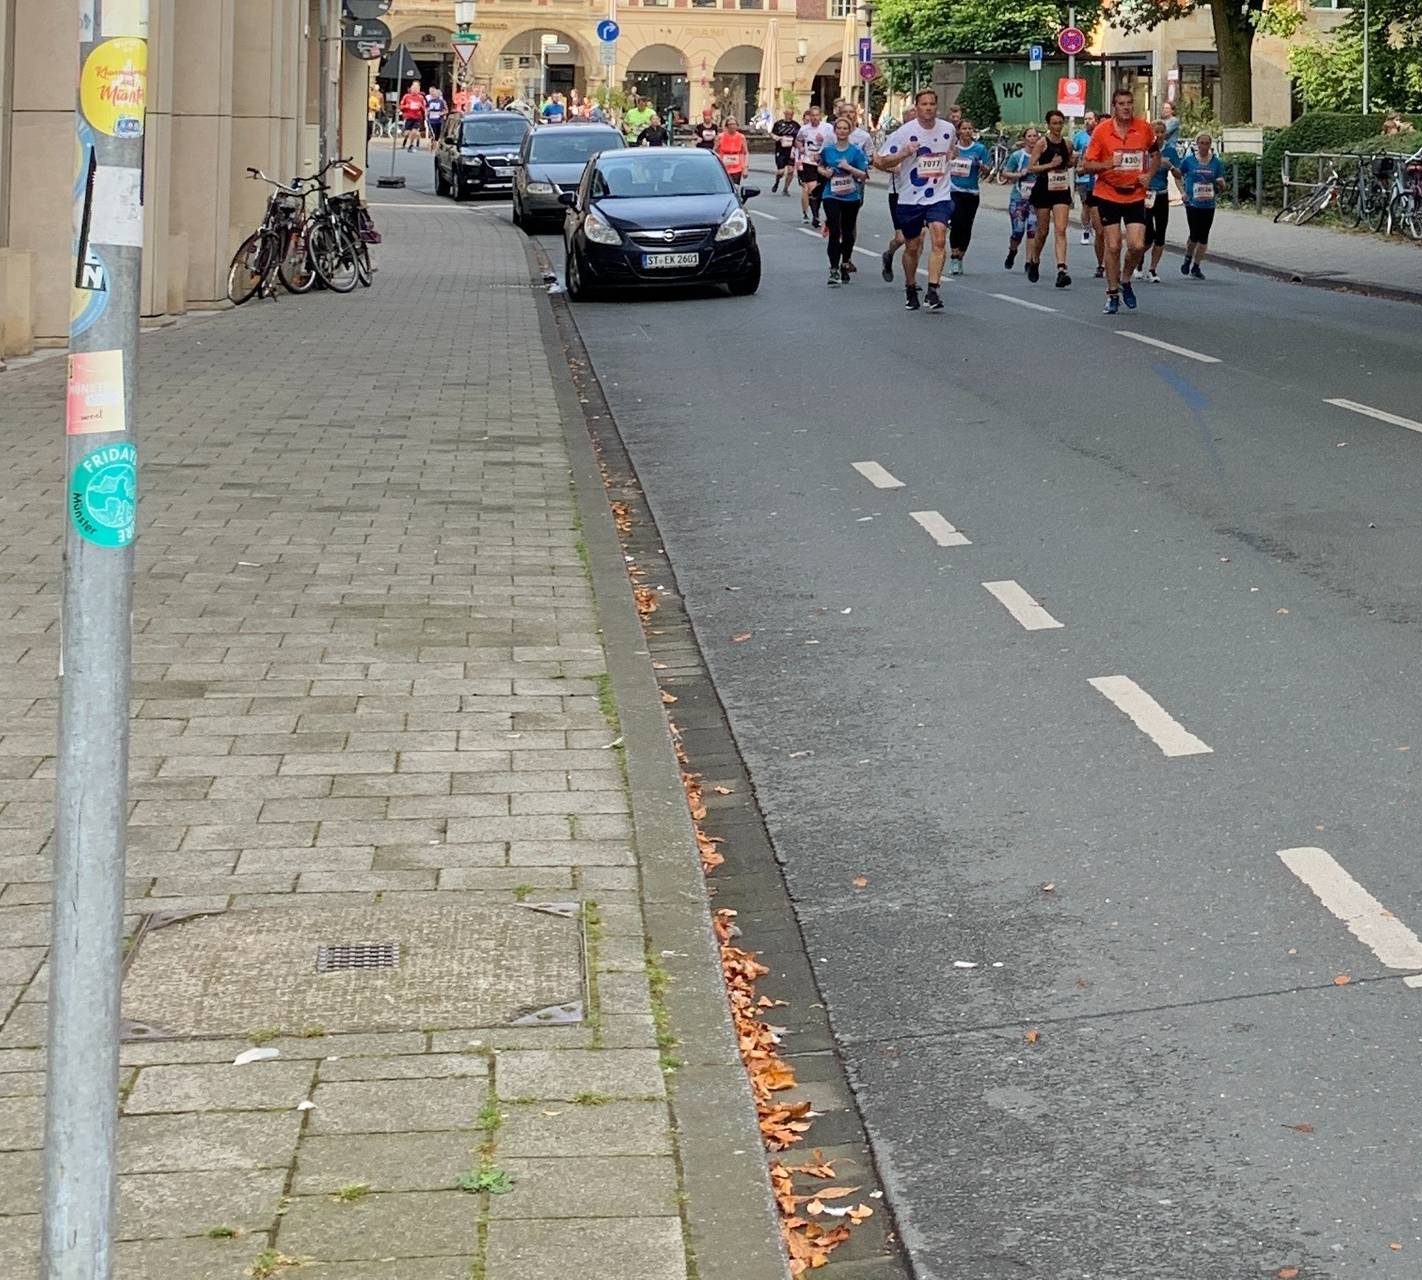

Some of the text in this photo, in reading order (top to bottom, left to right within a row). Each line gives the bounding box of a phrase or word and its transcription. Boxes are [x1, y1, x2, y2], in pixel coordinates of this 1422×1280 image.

[1003, 82, 1023, 98] WC
[648, 255, 658, 266] ST
[73, 492, 98, 535] Münster
